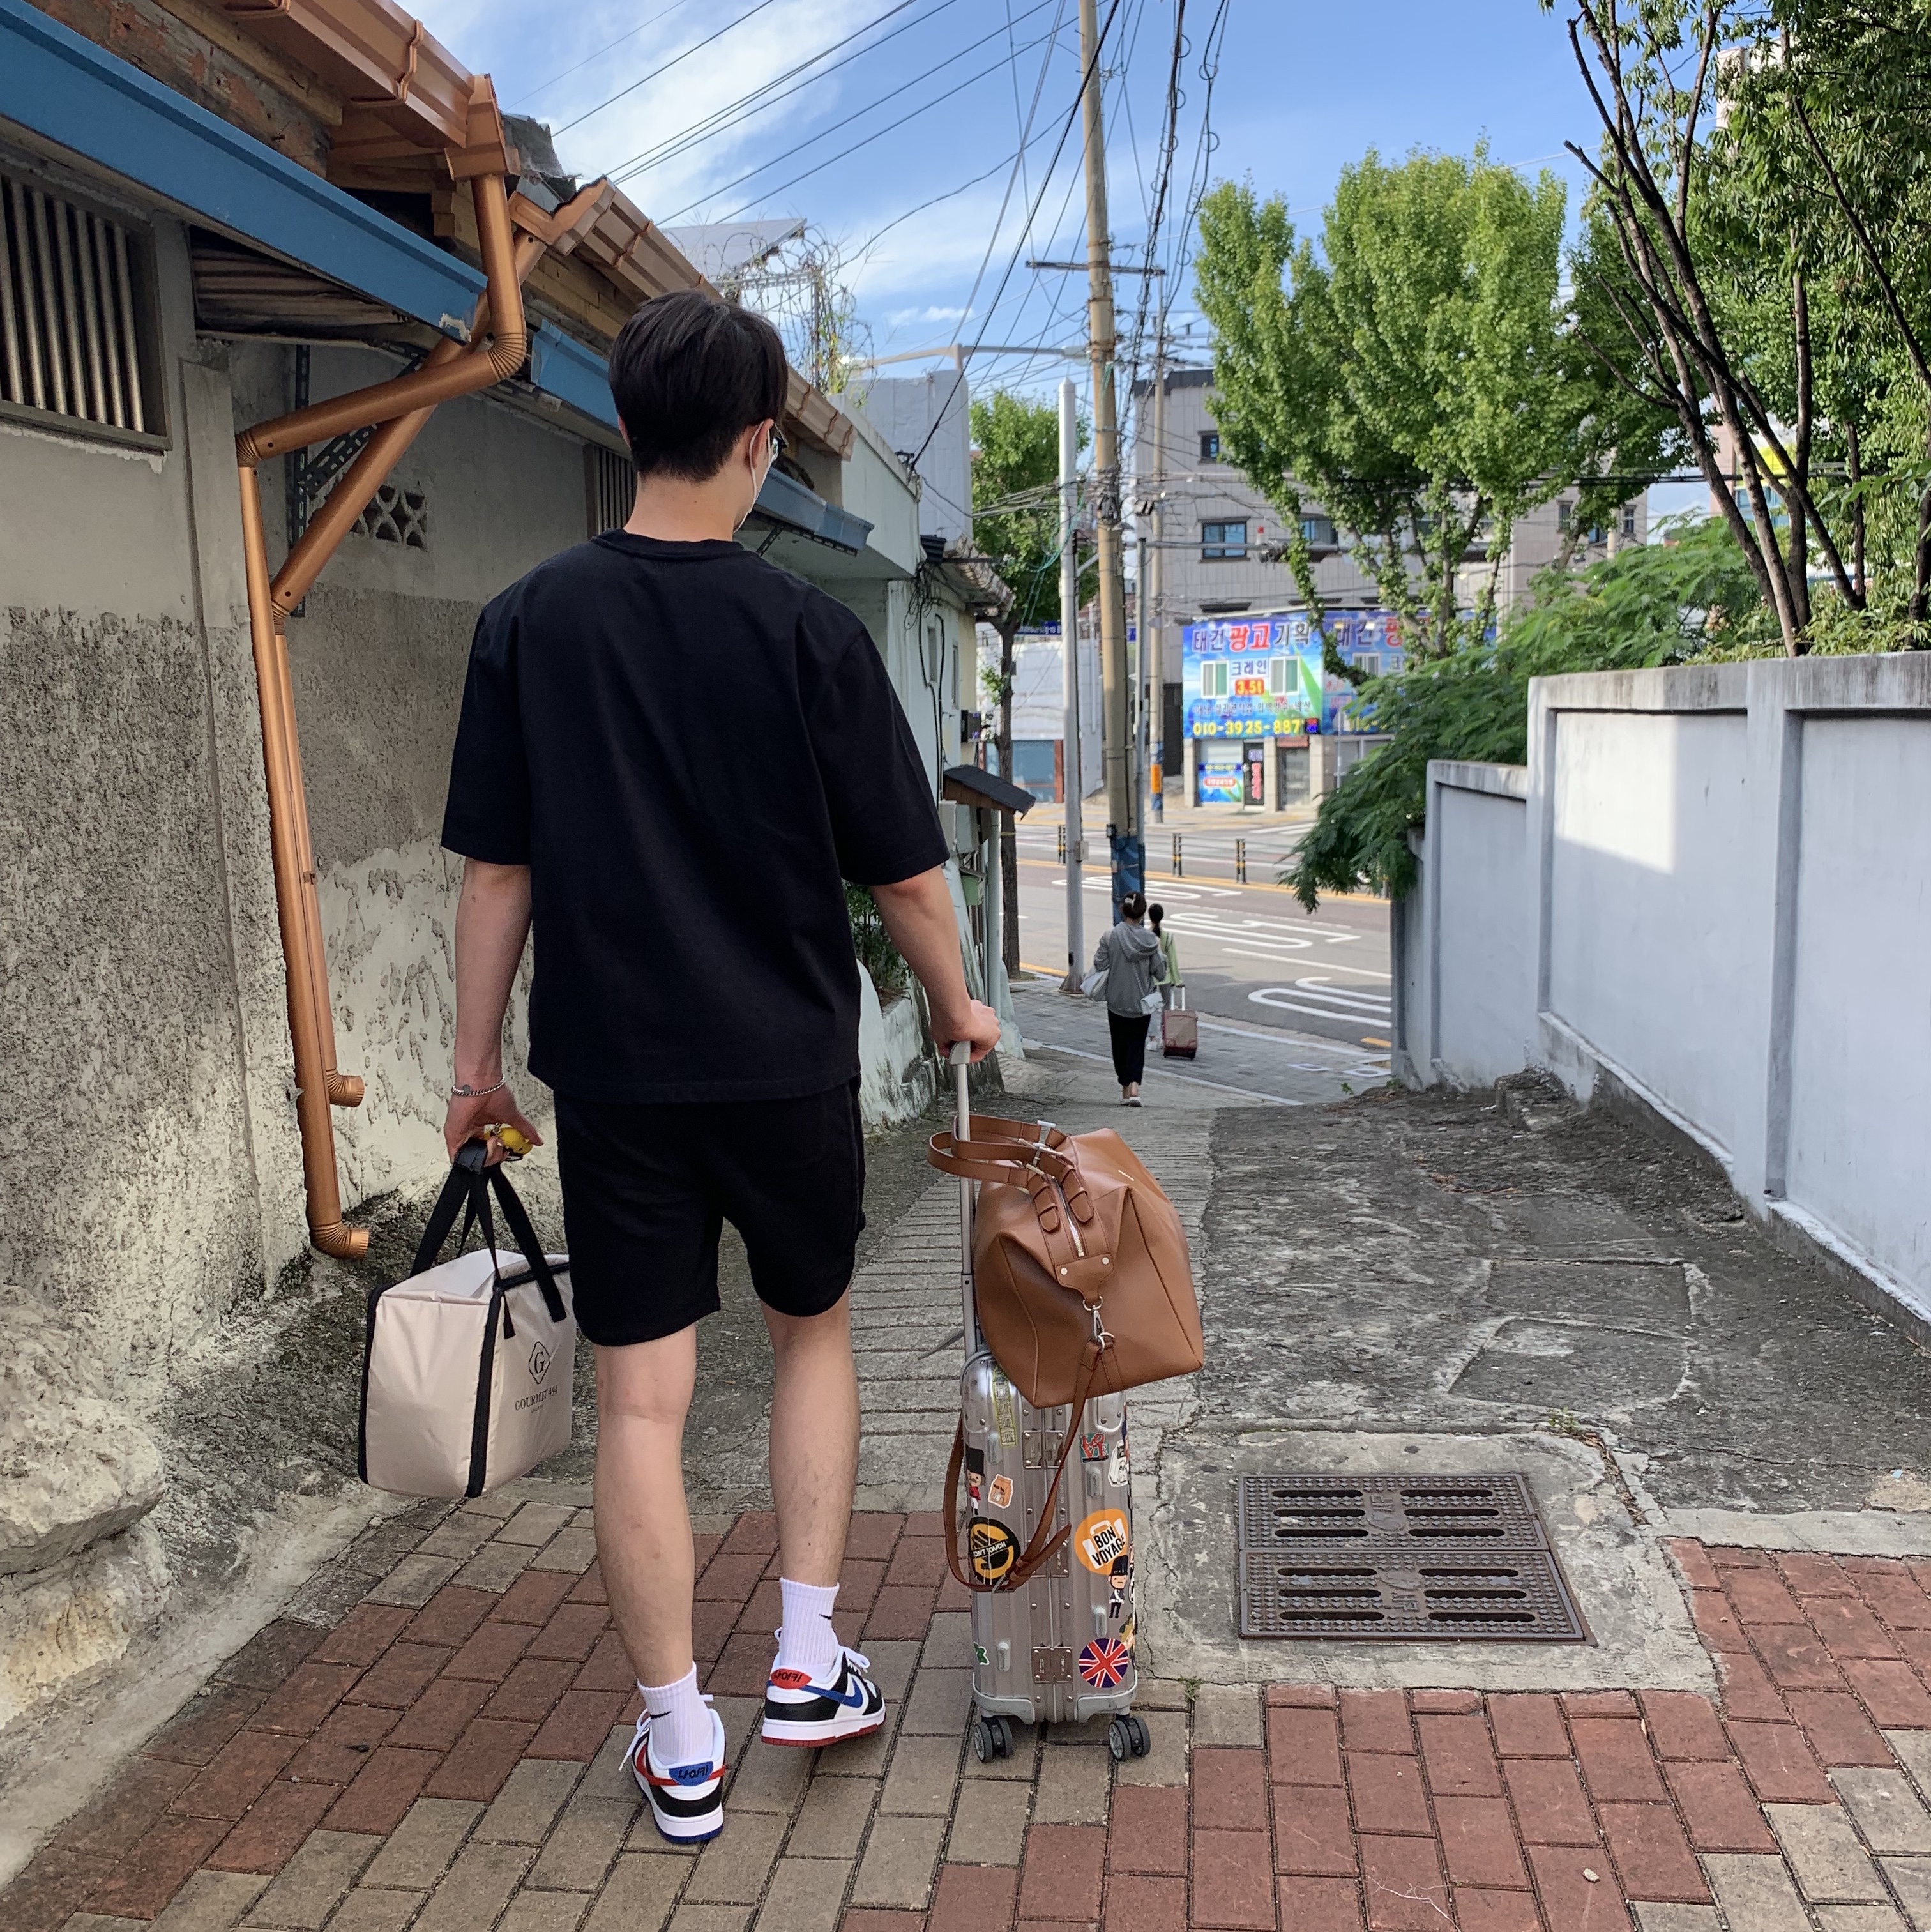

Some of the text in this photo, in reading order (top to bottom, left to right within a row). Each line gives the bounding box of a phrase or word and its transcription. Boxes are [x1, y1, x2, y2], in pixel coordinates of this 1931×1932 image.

[1193, 628, 1225, 652] 태건
[1230, 624, 1270, 651] 광고
[1231, 660, 1267, 676] 크레인
[1193, 718, 1305, 736] 010-3925-887
[534, 1351, 545, 1374] G
[986, 1540, 1007, 1553] TOUCH
[1093, 1526, 1116, 1549] BON
[1091, 1533, 1126, 1566] VOYAGE
